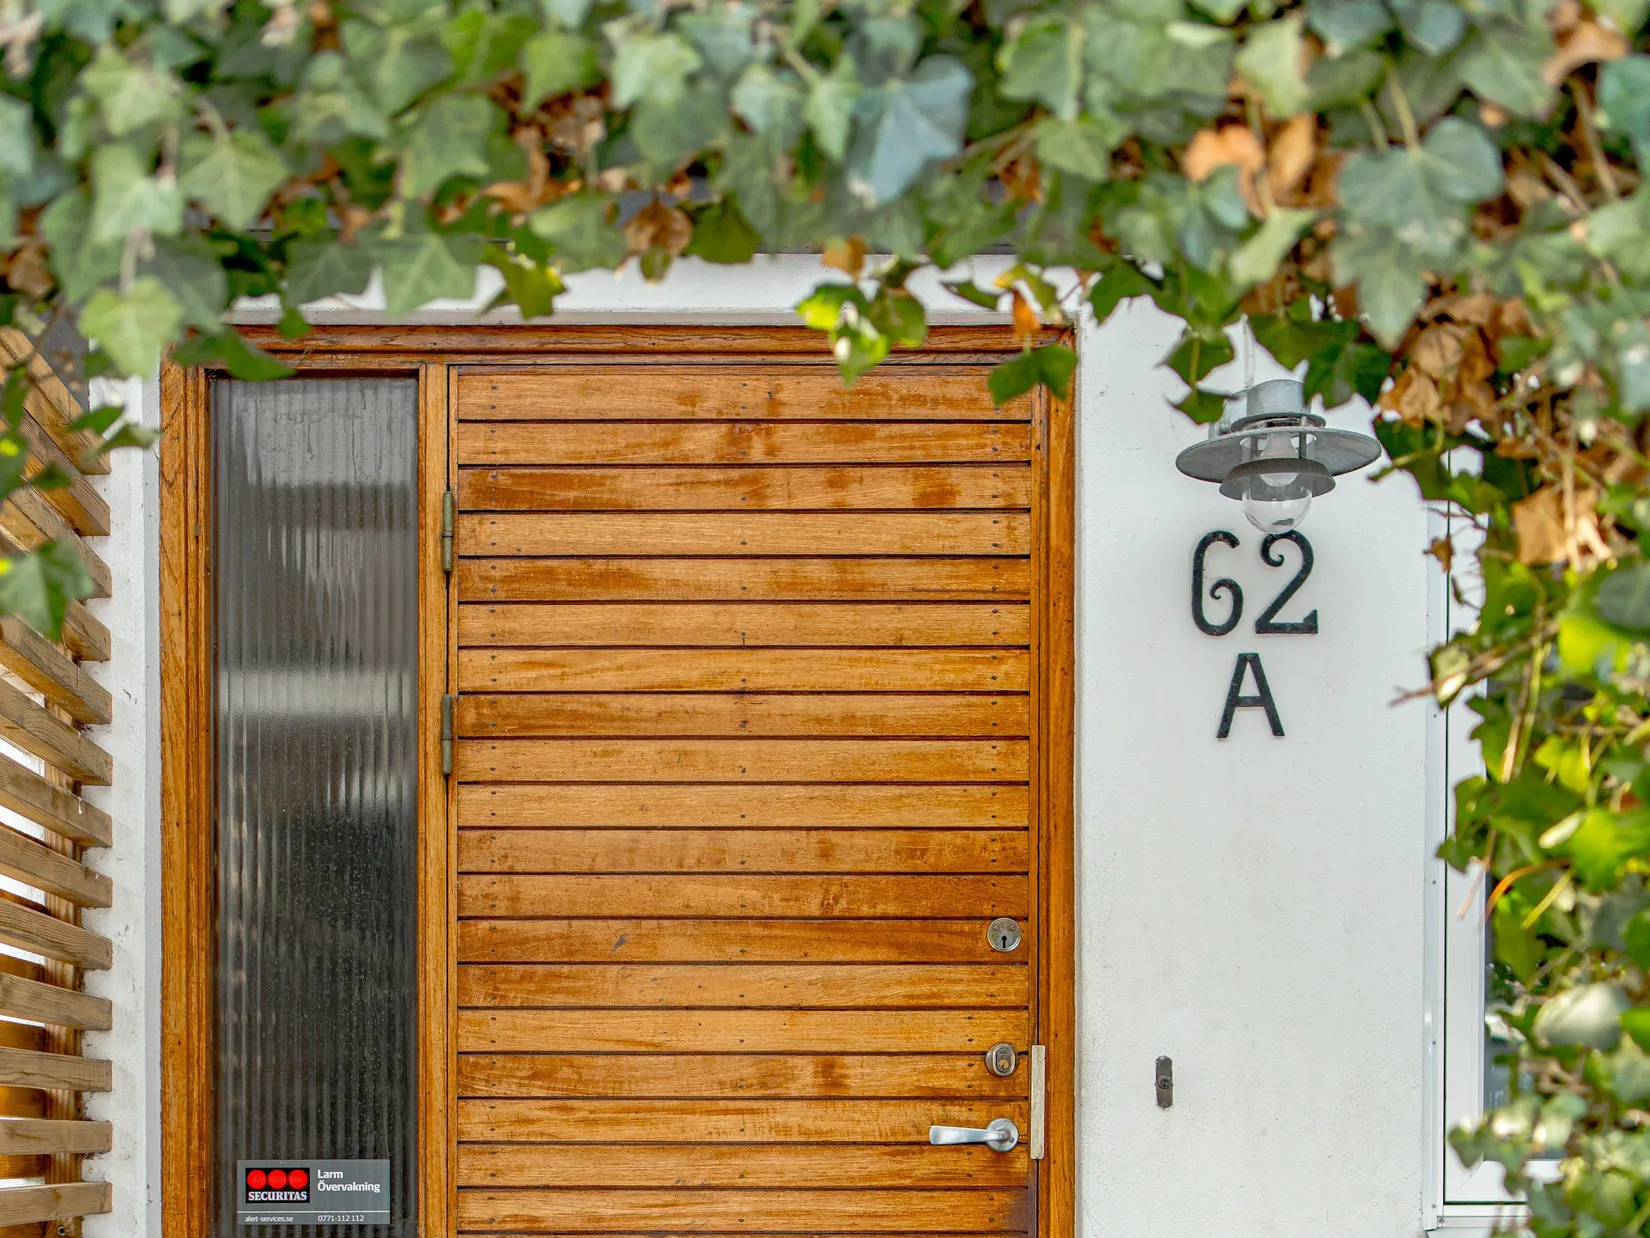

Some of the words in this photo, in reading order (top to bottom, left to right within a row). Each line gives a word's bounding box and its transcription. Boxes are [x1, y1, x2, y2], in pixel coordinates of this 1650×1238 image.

[1191, 529, 1319, 637] 62
[1216, 652, 1285, 739] A
[317, 1169, 344, 1179] Larm
[317, 1180, 381, 1193] Övervakning
[248, 1191, 308, 1201] SECURITAS
[244, 1215, 294, 1223] alert-services.se
